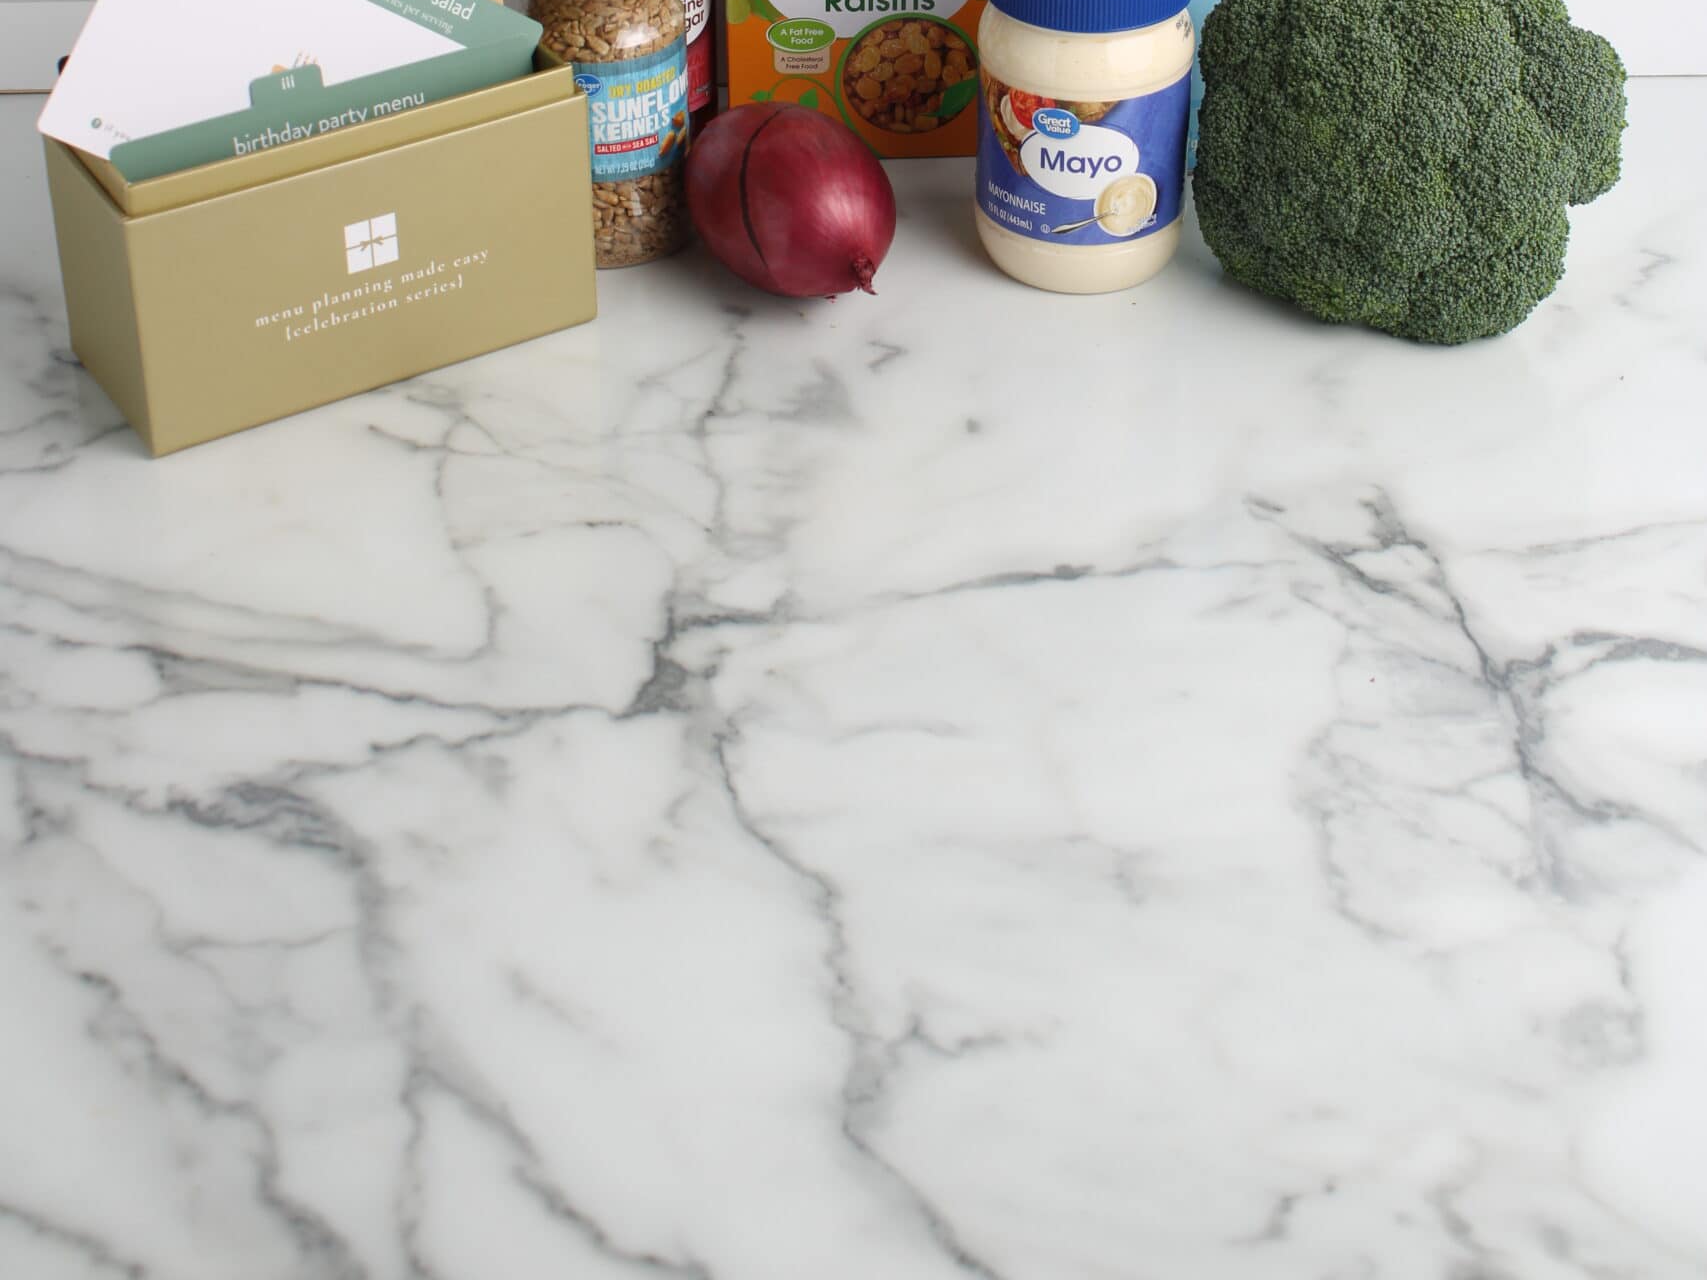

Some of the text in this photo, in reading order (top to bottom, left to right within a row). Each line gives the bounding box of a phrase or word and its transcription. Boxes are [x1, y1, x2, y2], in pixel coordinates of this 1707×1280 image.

[780, 28, 824, 36] A Fat Free
[791, 37, 814, 45] Food
[233, 92, 425, 155] birthday party menu
[593, 106, 671, 143] KERNELS
[1037, 113, 1071, 128] Great
[1045, 125, 1072, 135] Value
[597, 144, 622, 153] SALTED
[632, 138, 645, 150] SEA
[644, 135, 659, 146] SALT
[1040, 147, 1122, 178] Mayo
[988, 181, 1046, 216] MAYONNAISE
[999, 208, 1007, 221] OZ
[1006, 212, 1033, 232] (443mL)
[255, 249, 489, 328] menu planning made easy
